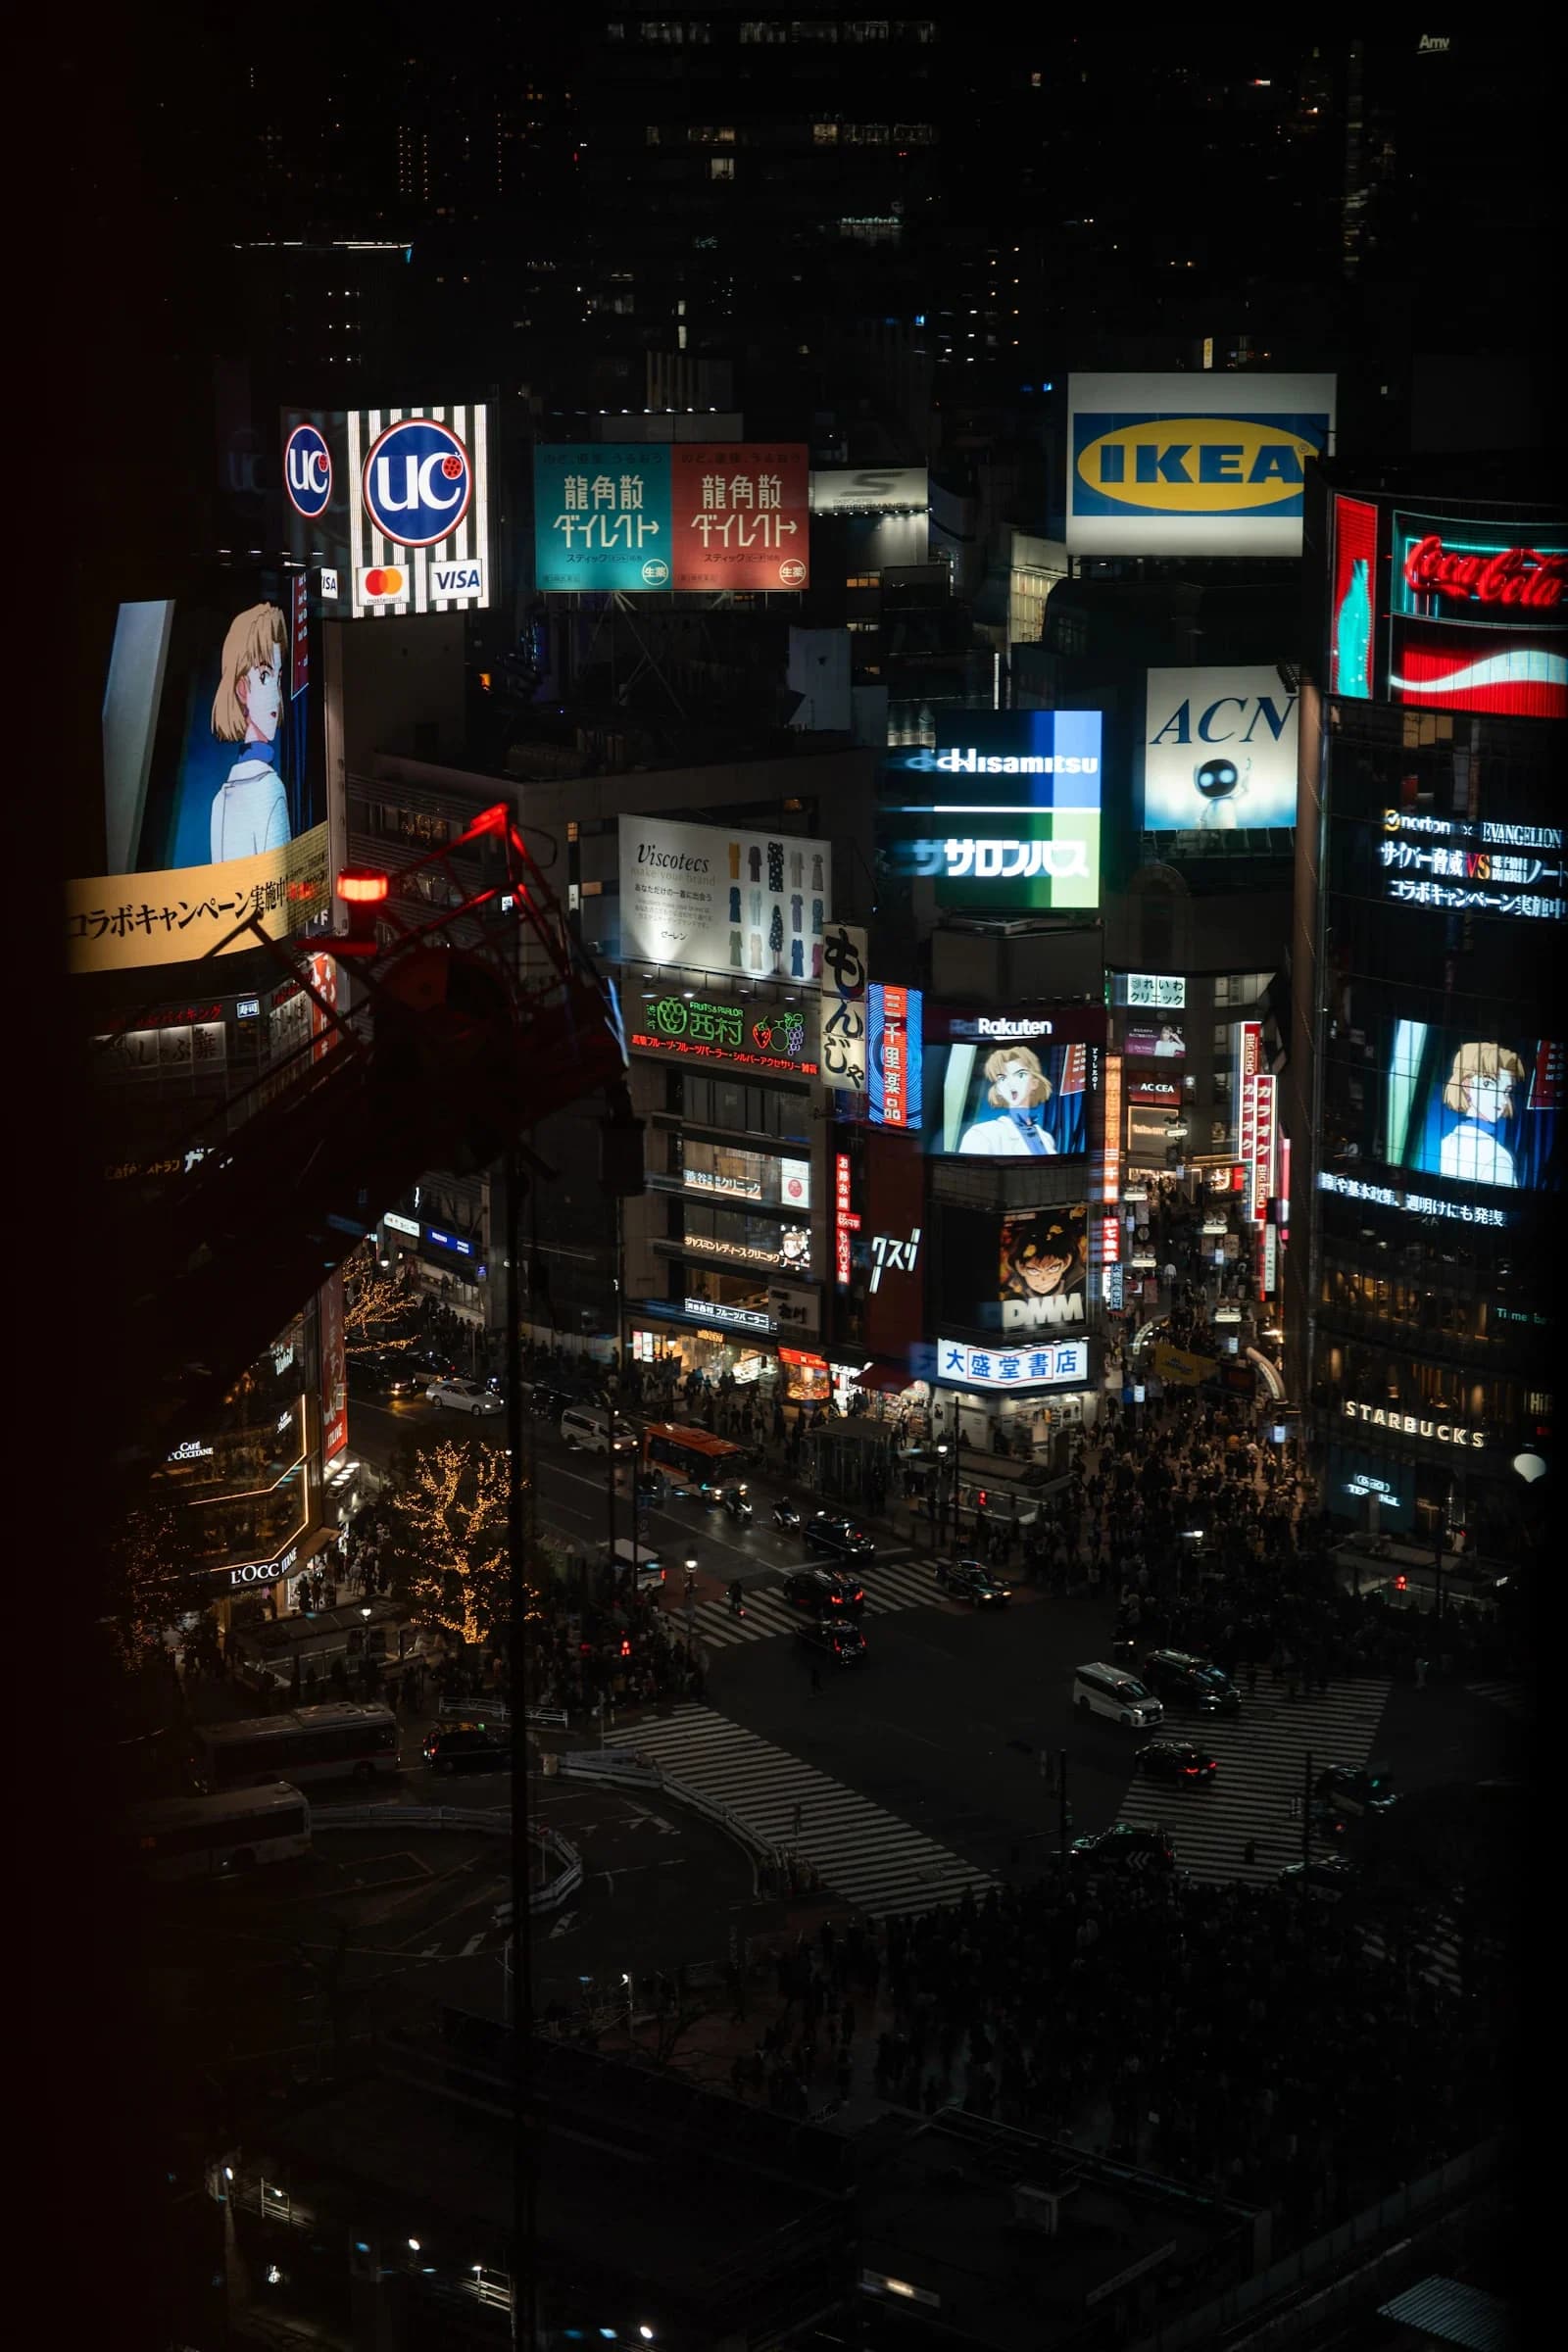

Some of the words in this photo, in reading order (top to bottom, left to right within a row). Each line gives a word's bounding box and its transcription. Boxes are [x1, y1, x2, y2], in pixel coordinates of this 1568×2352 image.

[1101, 445, 1303, 483] IKEA
[377, 452, 462, 512] UC
[564, 474, 643, 510] 龍角散
[702, 474, 782, 510] 龍角散
[553, 514, 660, 549] ダイレクト
[691, 514, 798, 549] ダイレクト
[437, 569, 480, 590] VISA
[1403, 535, 1564, 607] Coca-Cola
[1149, 697, 1299, 745] ACN
[938, 748, 1099, 773] Hisamitsu
[1399, 814, 1451, 835] norton
[1483, 822, 1562, 850] EVANGELION
[637, 843, 710, 873] Viscotecs
[1130, 992, 1184, 1005] クリニック
[1144, 979, 1184, 992] れいわ
[689, 1012, 744, 1047] 西村
[978, 1017, 1053, 1035] Rakuten
[884, 993, 902, 1121] 三千里薬品
[1140, 1083, 1175, 1094] ACCEA
[1003, 1293, 1085, 1328] DMM
[946, 1348, 1077, 1380] 大盛堂書店
[1345, 1400, 1486, 1449] STARBUCKS
